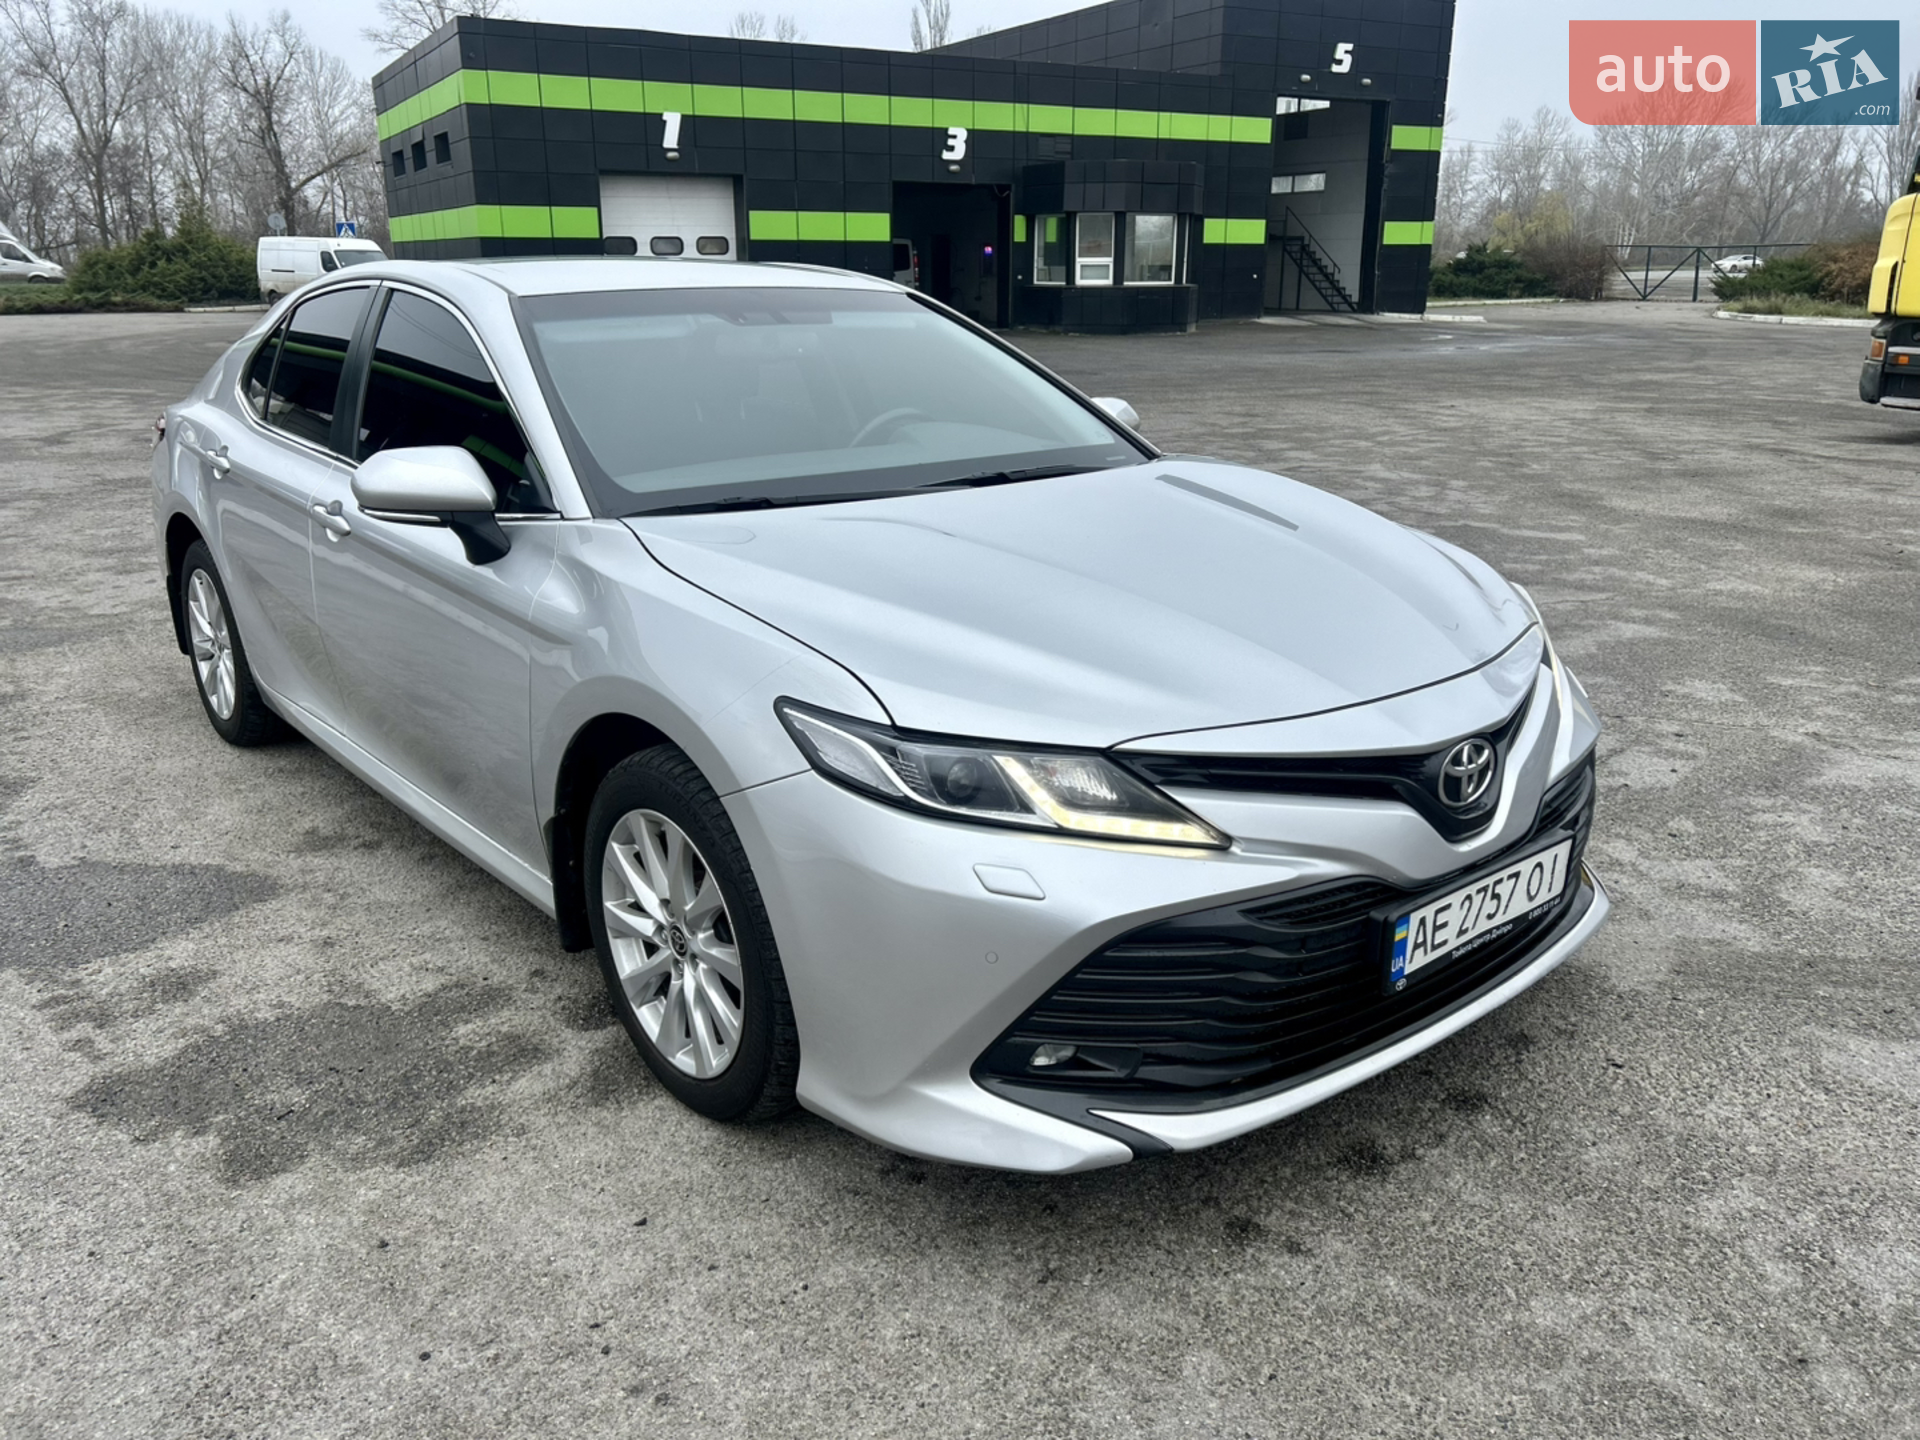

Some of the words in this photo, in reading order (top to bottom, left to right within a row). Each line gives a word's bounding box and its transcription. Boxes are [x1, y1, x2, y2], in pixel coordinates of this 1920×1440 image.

[1331, 42, 1354, 73] 5
[662, 111, 681, 149] 1
[941, 126, 968, 160] 3
[1409, 902, 1453, 965] AE
[1456, 870, 1522, 940] 2757
[1391, 955, 1405, 973] UA
